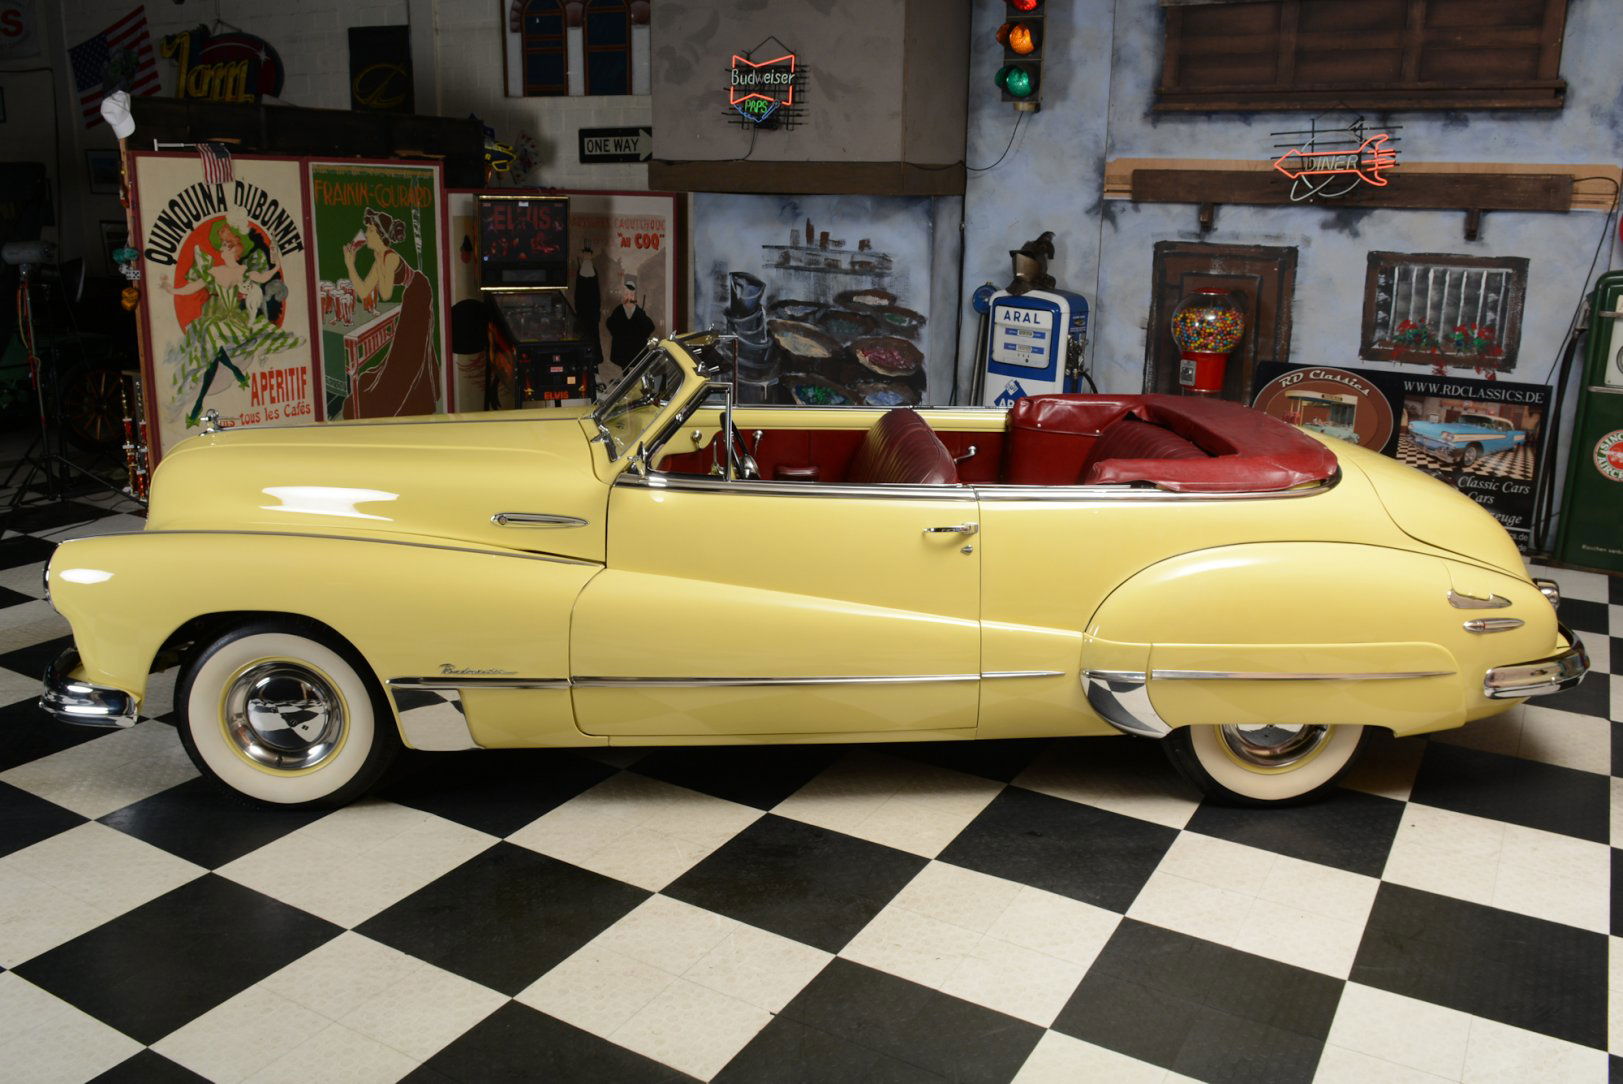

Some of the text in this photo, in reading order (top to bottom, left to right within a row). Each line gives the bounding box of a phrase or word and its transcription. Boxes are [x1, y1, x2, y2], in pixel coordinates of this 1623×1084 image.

[731, 68, 796, 85] Budweiser
[586, 136, 640, 153] ONE WAY
[1304, 154, 1359, 171] DINER
[144, 179, 305, 266] QUINQUINA DUBONNET
[1003, 310, 1041, 324] ARAL
[1278, 369, 1370, 397] RD Classics
[1403, 380, 1544, 403] WWW.RDCLASSICS.DE
[239, 412, 261, 425] tous
[264, 407, 280, 420] les
[1457, 475, 1531, 494] Classic Cars
